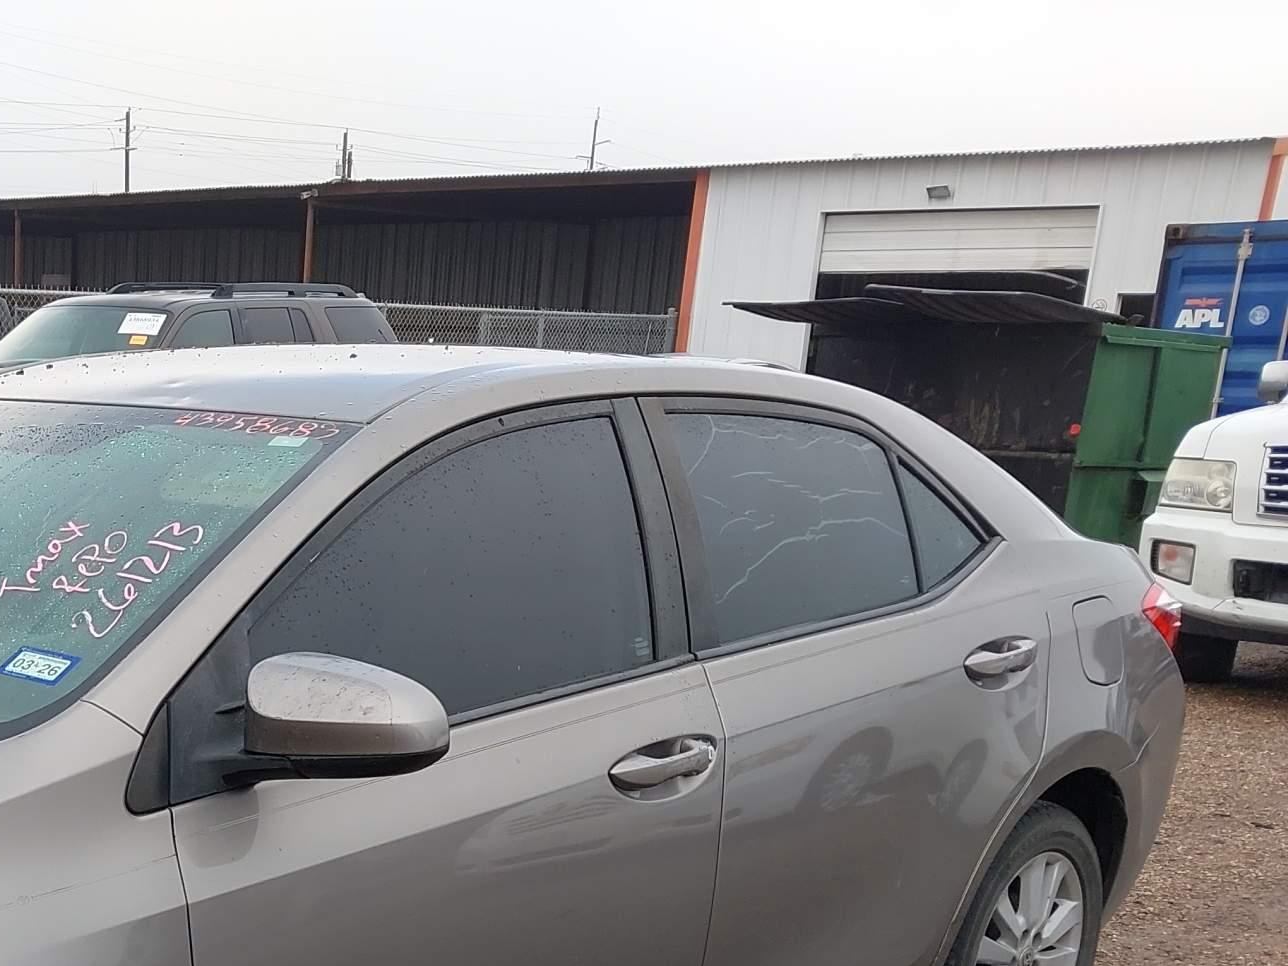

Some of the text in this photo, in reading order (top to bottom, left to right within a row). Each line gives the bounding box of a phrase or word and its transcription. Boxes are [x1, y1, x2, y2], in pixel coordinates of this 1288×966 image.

[1174, 308, 1225, 328] APL
[174, 411, 340, 440] 43958683
[71, 522, 204, 638] 261213
